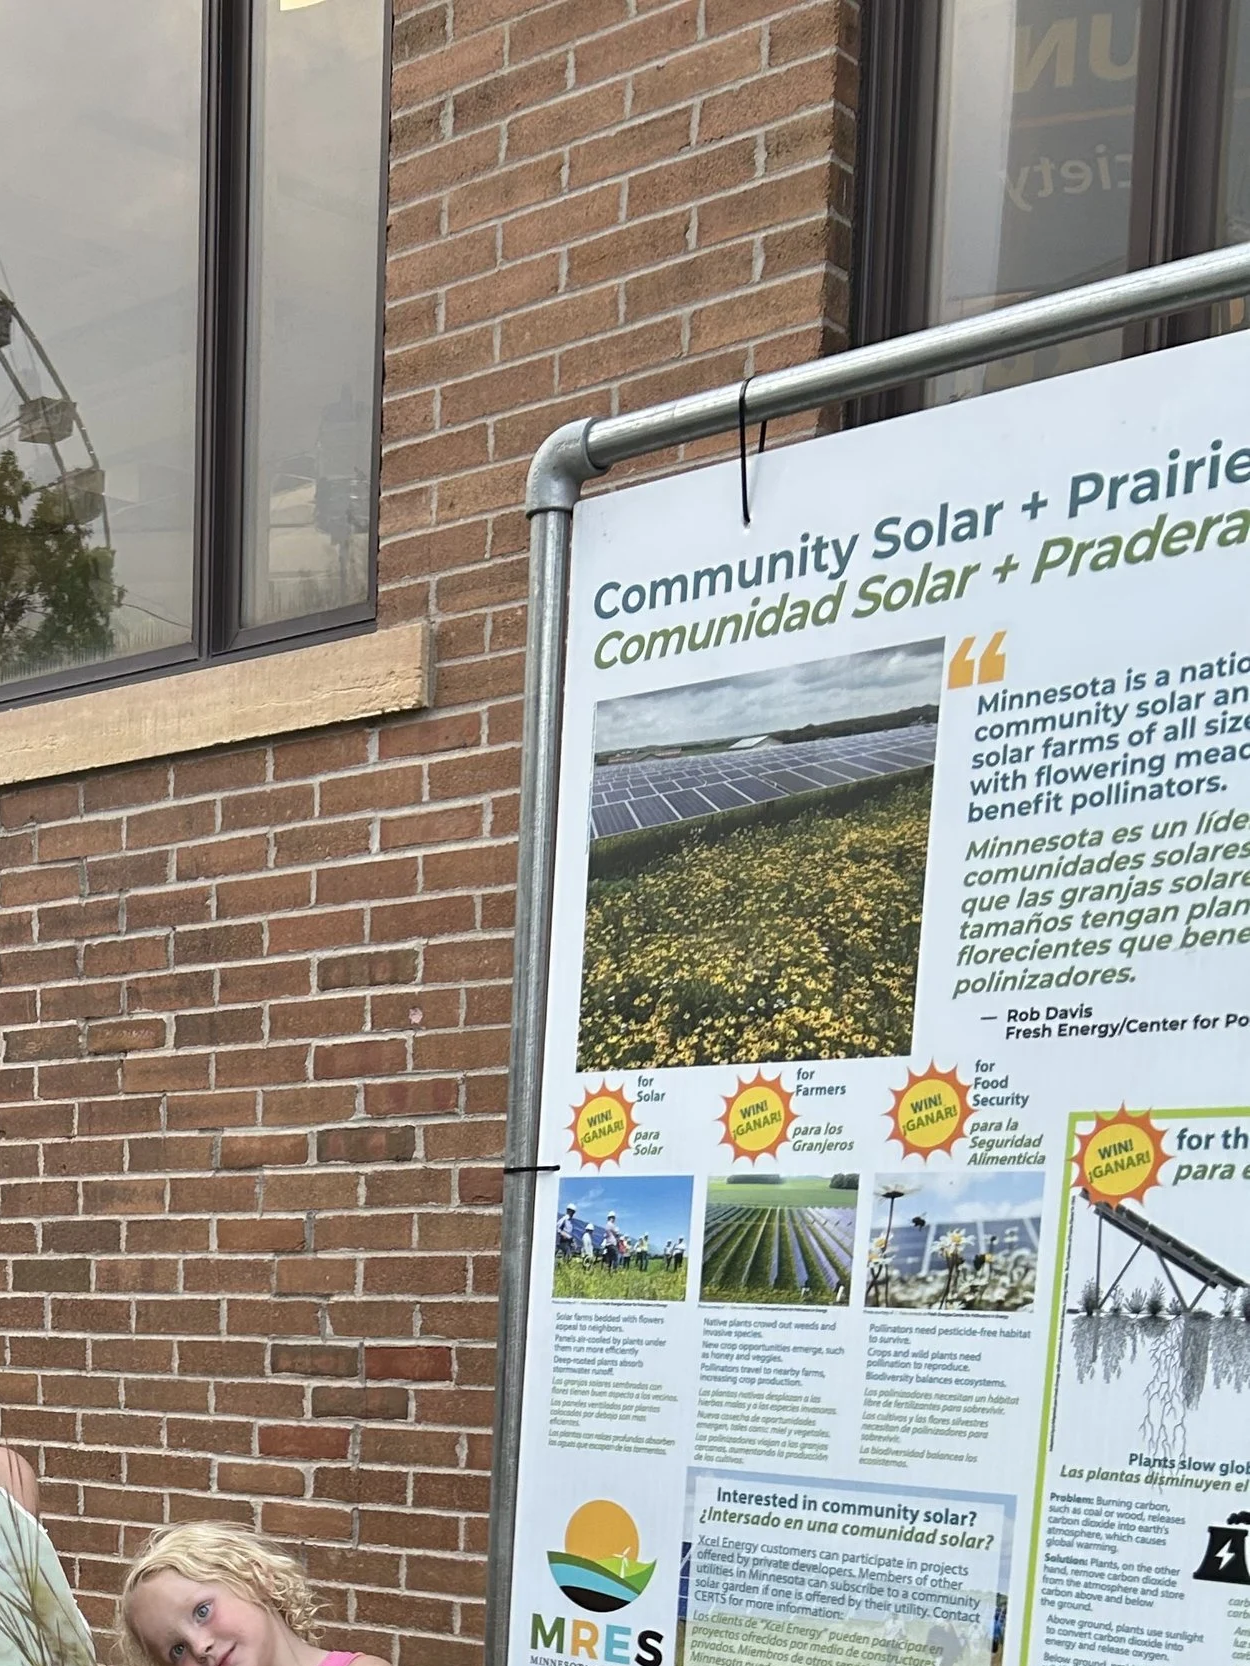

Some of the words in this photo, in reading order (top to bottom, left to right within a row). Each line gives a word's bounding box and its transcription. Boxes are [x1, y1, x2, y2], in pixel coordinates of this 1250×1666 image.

[594, 533, 859, 619] Community
[872, 502, 1004, 560] Solar
[1021, 490, 1049, 521] +
[1068, 440, 1250, 518] Prairie
[594, 577, 847, 669] Comunidad
[851, 562, 981, 619] Solar
[992, 553, 1020, 584] +
[1031, 509, 1250, 583] Pradera
[977, 678, 1116, 715] Minnesota
[1125, 669, 1147, 693] is
[1154, 669, 1170, 688] a
[1179, 653, 1250, 684] natio
[974, 702, 1129, 742] community
[1135, 691, 1206, 718] solar
[971, 743, 1035, 770] solar
[1041, 733, 1120, 759] farms
[1127, 721, 1158, 747] of
[1163, 715, 1197, 743] all
[1204, 711, 1250, 737] size
[969, 769, 1027, 796] with
[1035, 753, 1166, 793] flowering
[967, 791, 1063, 823] benefit
[1070, 775, 1227, 815] pollinators.
[965, 828, 1104, 861] Minnesota
[1111, 825, 1144, 845] es
[1150, 820, 1188, 841] un
[1194, 808, 1250, 835] líde
[963, 850, 1146, 887] comunidades
[1150, 841, 1250, 868] solares
[961, 894, 1011, 919] que
[1016, 886, 1055, 909] las
[1058, 876, 1164, 910] granjas
[959, 912, 1074, 940] tamaños
[1080, 905, 1180, 931] tengan
[1184, 895, 1250, 928] plan
[956, 938, 1112, 966] florecientes
[1118, 933, 1173, 959] que
[1178, 926, 1250, 949] bene
[952, 966, 1136, 999] polinizadores.
[1005, 1023, 1052, 1040] Fresh
[1057, 1018, 1188, 1038] Energy/Center
[1192, 1014, 1220, 1030] for
[1224, 1013, 1250, 1028] Po
[1007, 1006, 1041, 1023] Rob
[1045, 1003, 1093, 1021] Davis
[638, 1075, 655, 1087] for
[797, 1068, 815, 1080] for
[975, 1060, 995, 1073] for
[636, 1091, 666, 1103] Solar
[795, 1084, 846, 1096] Farmers
[973, 1076, 1008, 1090] Food
[740, 1100, 768, 1119] WIN!
[910, 1093, 942, 1114] WIN!
[971, 1093, 1029, 1108] Security
[587, 1109, 613, 1127] WIN!
[732, 1110, 782, 1140] ¡GANAR!
[792, 1125, 822, 1139] para
[824, 1123, 843, 1135] los
[902, 1105, 957, 1135] ¡GANAR!
[970, 1120, 1001, 1135] para
[1005, 1118, 1018, 1131] la
[581, 1119, 625, 1148] ¡GANAR!
[633, 1131, 660, 1143] para
[792, 1139, 854, 1155] Granjeros
[969, 1134, 1043, 1151] Seguridad
[1176, 1127, 1214, 1150] for
[1222, 1126, 1249, 1149] th
[633, 1143, 663, 1156] Solar
[967, 1152, 1046, 1166] Alimenticia
[1098, 1139, 1134, 1161] WIN!
[1089, 1150, 1151, 1183] ¡GANAR!
[1172, 1163, 1236, 1185] para
[1128, 1452, 1176, 1470] Plants
[1177, 1456, 1216, 1472] slow
[1059, 1464, 1084, 1479] Las
[1085, 1467, 1141, 1484] plantas
[1143, 1470, 1232, 1492] disminuyen
[1234, 1478, 1250, 1493] el
[717, 1487, 799, 1509] Interested
[802, 1494, 818, 1512] in
[821, 1501, 920, 1525] community
[923, 1509, 978, 1527] solar?
[699, 1506, 781, 1528] ¿Intersado
[783, 1517, 804, 1531] en
[806, 1520, 839, 1534] una
[841, 1524, 938, 1545] comunidad
[939, 1531, 995, 1551] solar?
[696, 1548, 735, 1564] offered
[736, 1551, 751, 1568] by
[751, 1556, 791, 1571] private
[791, 1559, 857, 1579] developers.
[857, 1567, 913, 1585] Members
[914, 1574, 929, 1587] of
[929, 1577, 964, 1592] other
[697, 1534, 721, 1550] Xcel
[721, 1537, 759, 1555] Energy
[760, 1544, 817, 1559] customers
[818, 1550, 840, 1561] can
[841, 1553, 904, 1569] participate
[906, 1558, 918, 1570] in
[920, 1562, 969, 1577] projects
[694, 1576, 721, 1589] solar
[721, 1581, 760, 1595] garden
[761, 1583, 771, 1596] if
[770, 1588, 793, 1599] one
[794, 1588, 804, 1601] is
[804, 1590, 846, 1606] offered
[847, 1594, 864, 1610] by
[864, 1597, 894, 1612] their
[892, 1603, 931, 1618] utility.
[932, 1606, 981, 1624] Contact
[696, 1563, 735, 1578] utilities
[735, 1566, 747, 1579] in
[748, 1568, 806, 1587] Minnesota
[807, 1578, 829, 1589] can
[829, 1580, 885, 1597] subscribe
[886, 1586, 900, 1599] to
[901, 1589, 909, 1600] a
[911, 1591, 982, 1611] community
[694, 1589, 727, 1605] CERTS
[728, 1593, 744, 1607] for
[745, 1599, 774, 1611] more
[775, 1601, 844, 1621] information:
